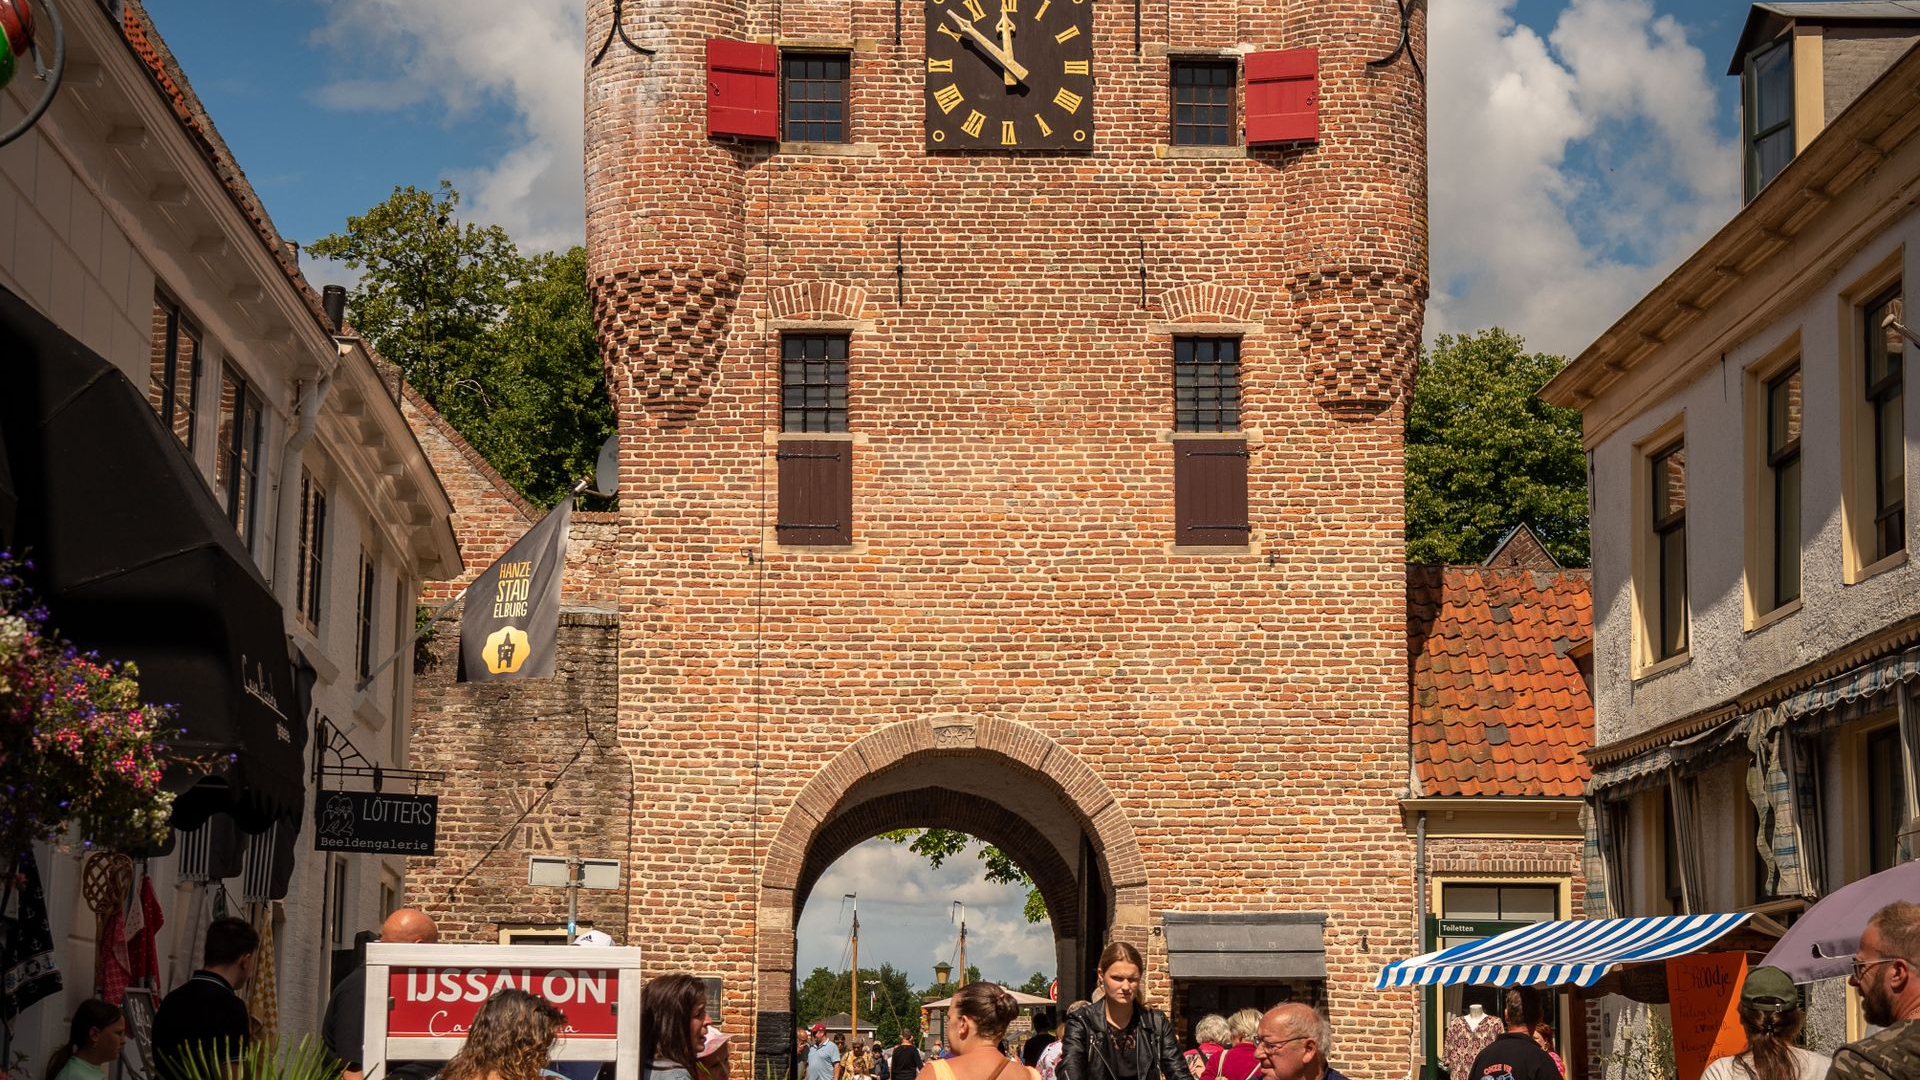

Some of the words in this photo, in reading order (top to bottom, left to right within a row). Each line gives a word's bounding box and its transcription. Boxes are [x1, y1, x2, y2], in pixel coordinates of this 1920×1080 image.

[499, 561, 532, 579] HANZE
[496, 577, 530, 603] STAD
[493, 602, 528, 619] ELBURG
[363, 797, 432, 825] LÖTTERS
[320, 837, 428, 851] Beeldengalerie
[1442, 924, 1474, 932] Toiletten
[407, 967, 607, 1004] IJSSALON
